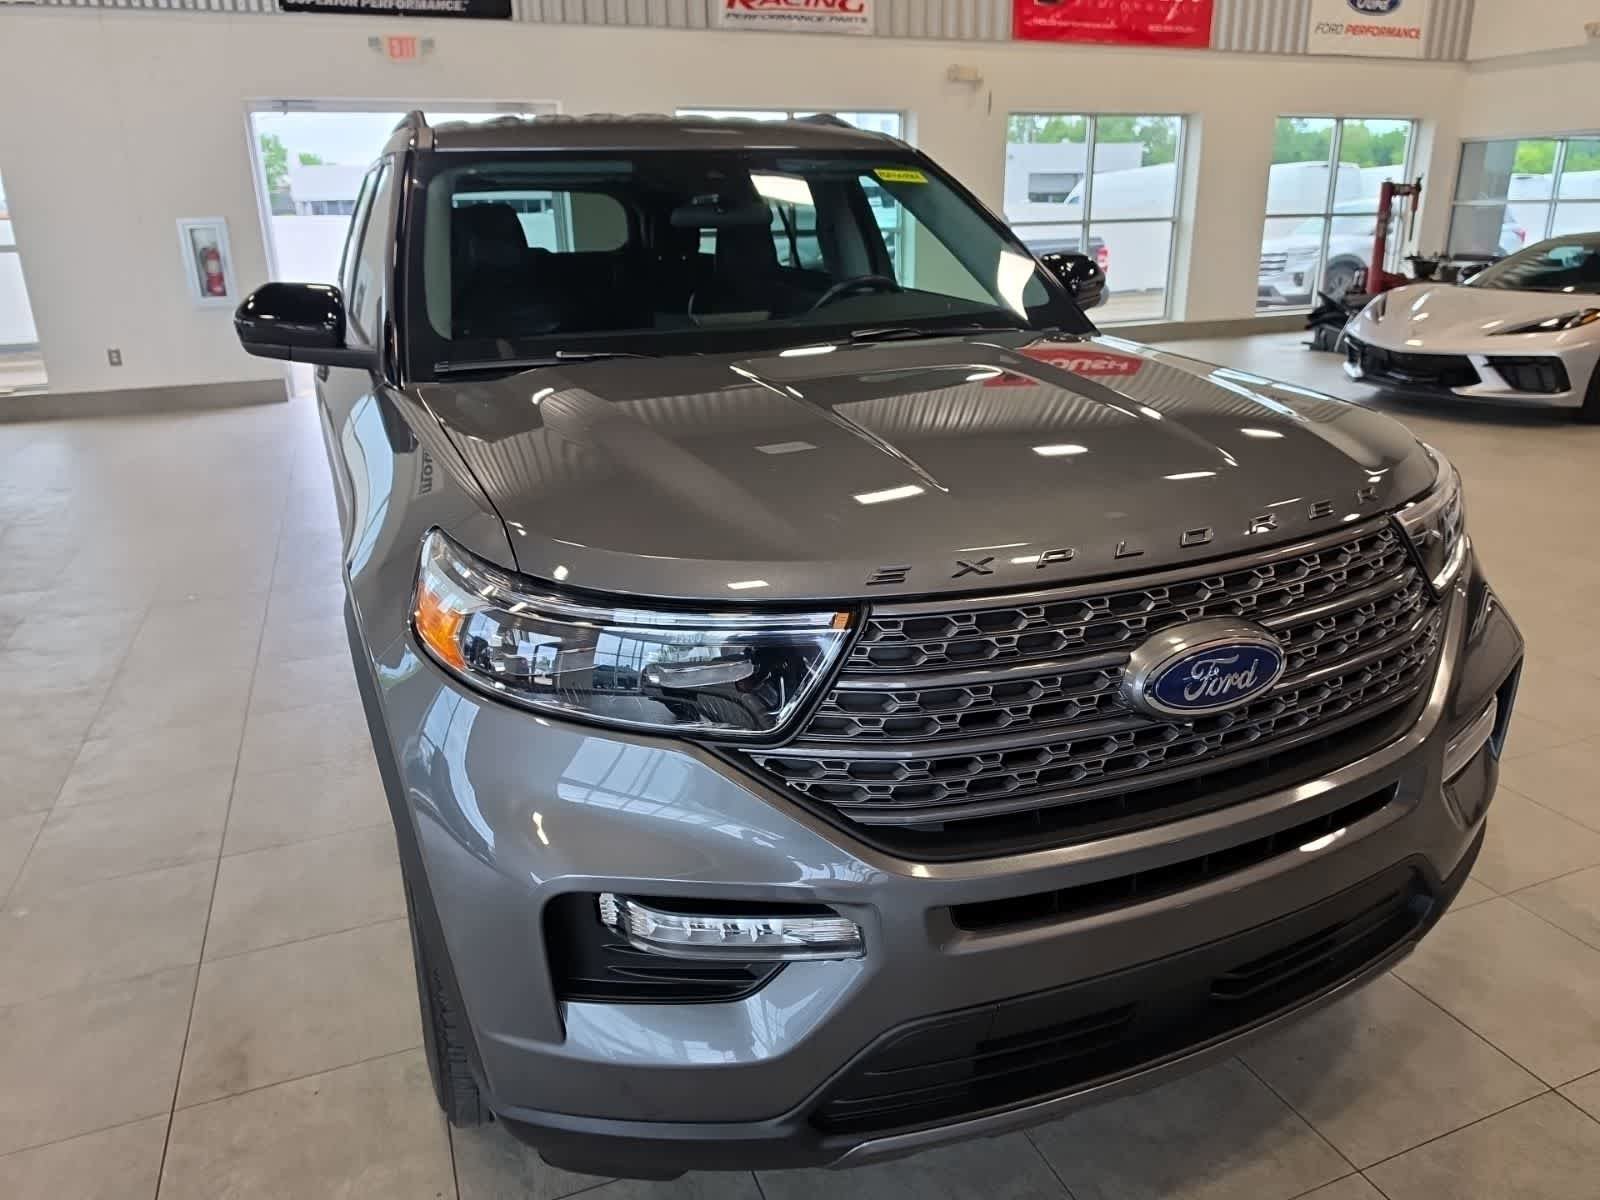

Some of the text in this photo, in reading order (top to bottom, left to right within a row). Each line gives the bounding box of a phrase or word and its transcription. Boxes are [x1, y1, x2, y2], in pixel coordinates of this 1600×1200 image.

[725, 12, 824, 23] PERFORMANCE
[1314, 22, 1420, 40] FORD PERFORMANCE
[865, 485, 1378, 586] EXPLORER
[1183, 653, 1260, 701] Ford
